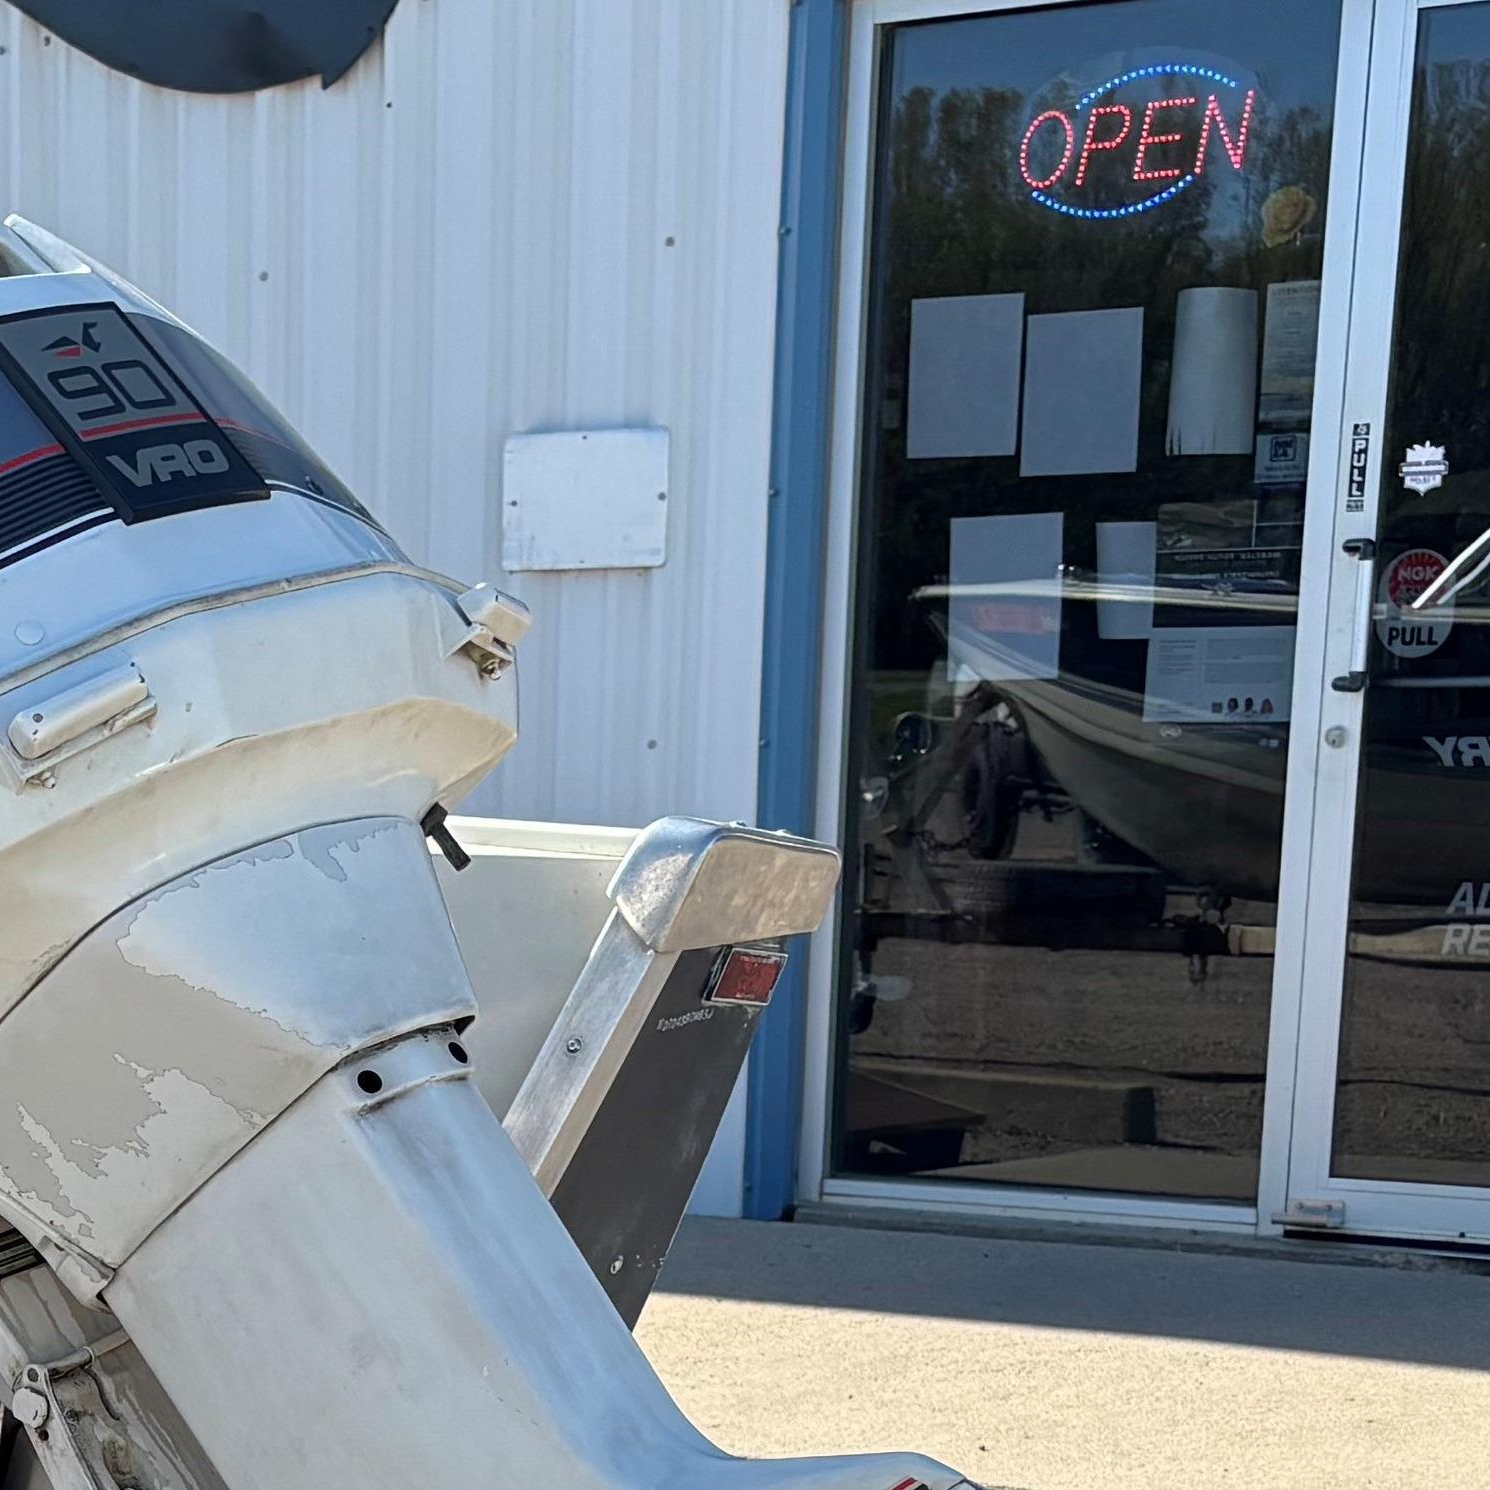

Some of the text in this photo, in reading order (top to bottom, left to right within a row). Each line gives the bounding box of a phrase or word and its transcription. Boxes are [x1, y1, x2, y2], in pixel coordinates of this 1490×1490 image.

[1020, 90, 1255, 189] OPEN
[47, 360, 176, 421] 90
[1350, 439, 1368, 496] PULL
[1398, 565, 1440, 583] NGK
[1387, 627, 1439, 646] PULL
